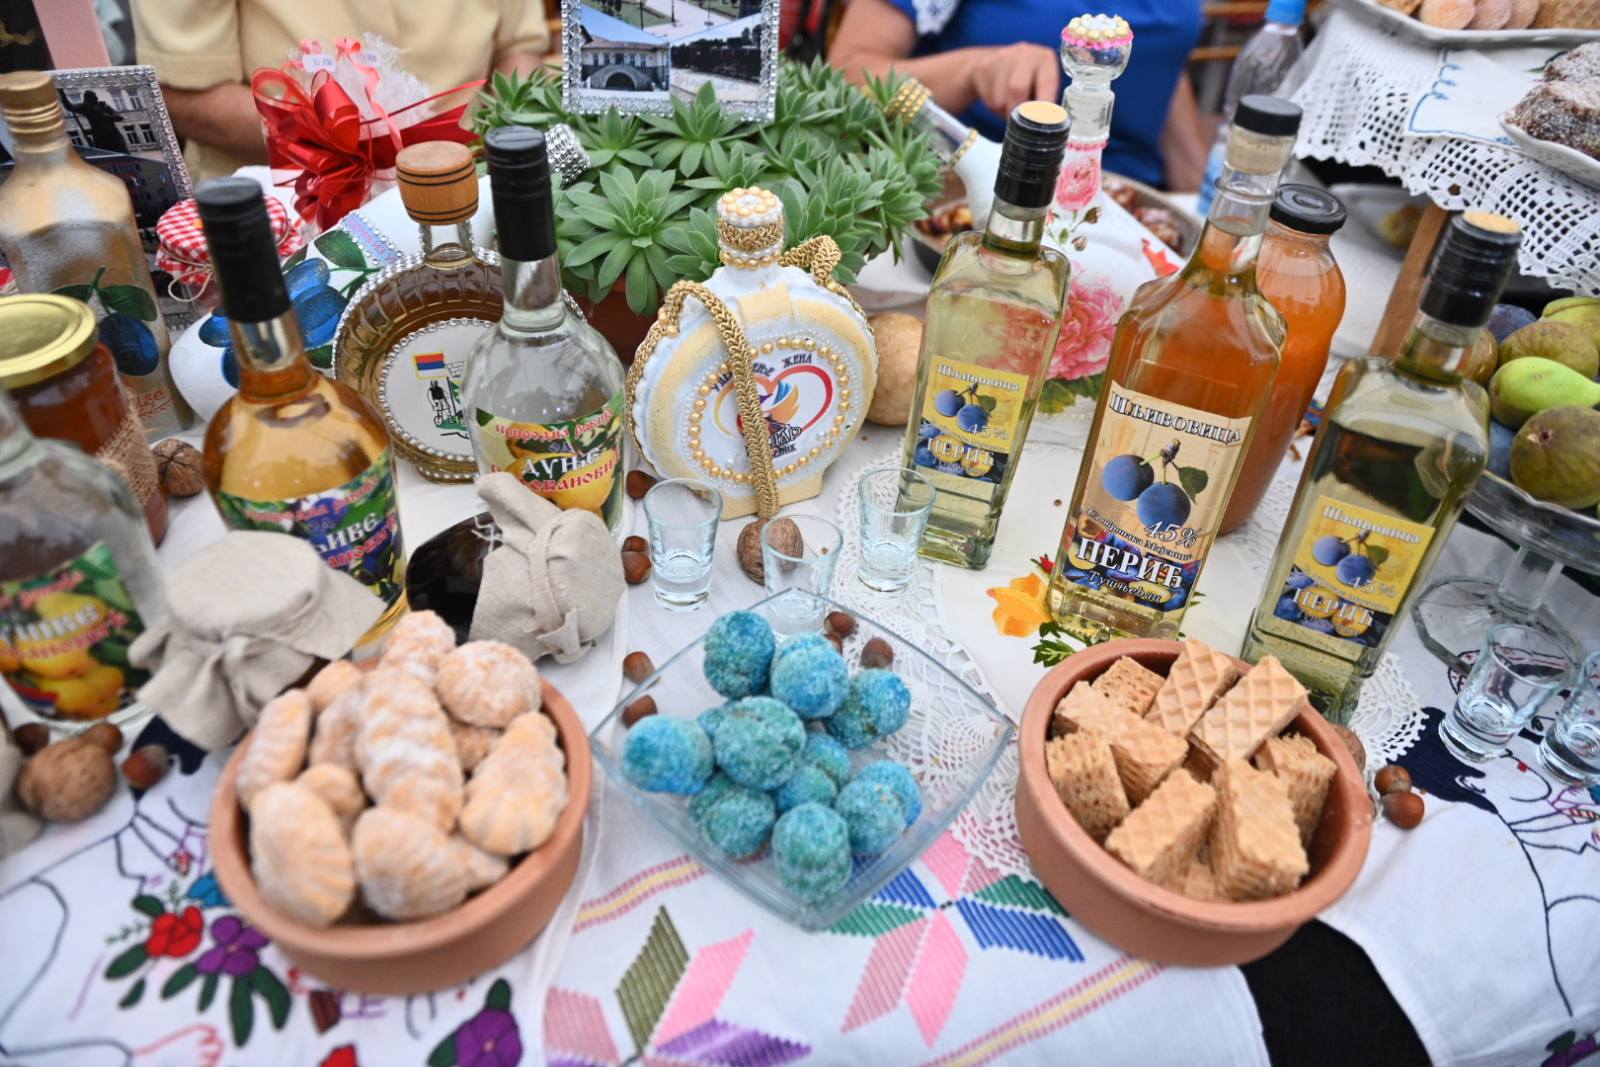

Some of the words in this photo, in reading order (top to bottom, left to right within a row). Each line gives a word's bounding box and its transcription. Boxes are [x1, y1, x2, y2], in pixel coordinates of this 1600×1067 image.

[782, 353, 812, 368] ЖЕНА
[1109, 390, 1241, 445] ШЉИВОВИЦА
[1144, 521, 1201, 548] 45%
[1077, 537, 1182, 588] ПЕРИЋ
